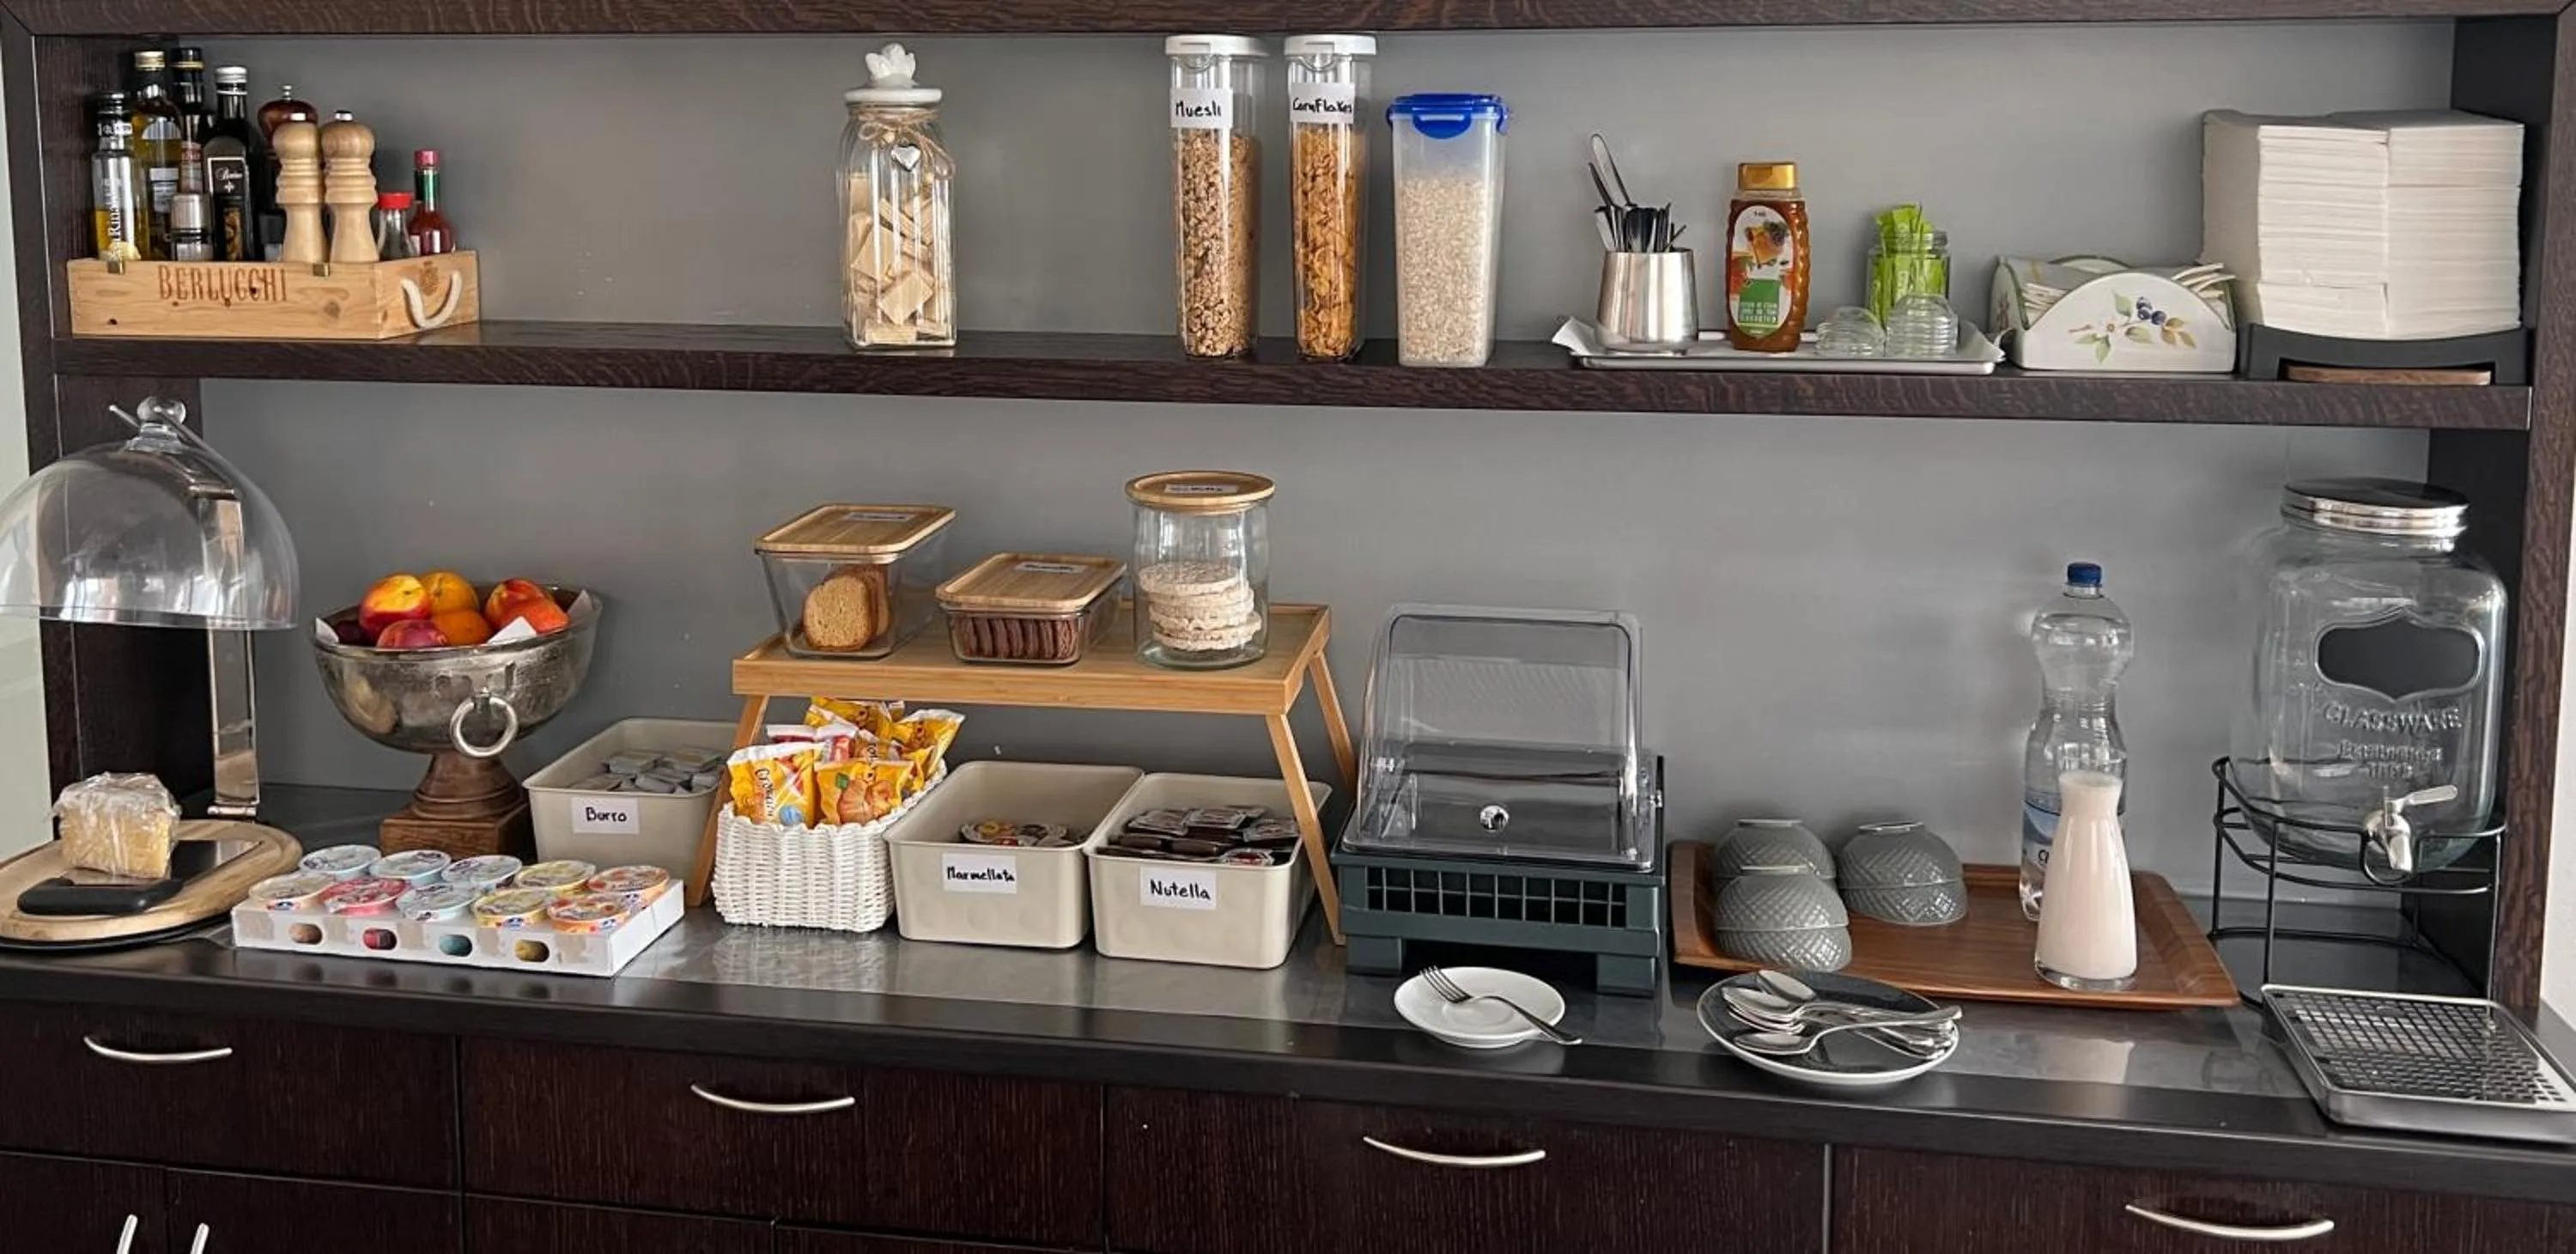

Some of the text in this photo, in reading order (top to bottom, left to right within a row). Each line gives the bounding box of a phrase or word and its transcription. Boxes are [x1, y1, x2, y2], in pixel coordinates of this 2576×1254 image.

[1175, 100, 1222, 118] Muesli
[158, 264, 288, 301] BERLUCCHI
[2323, 701, 2463, 734] GLASSWARE
[585, 806, 628, 822] Burro
[946, 865, 1015, 883] Marmellata
[1150, 879, 1212, 900] Nutella
